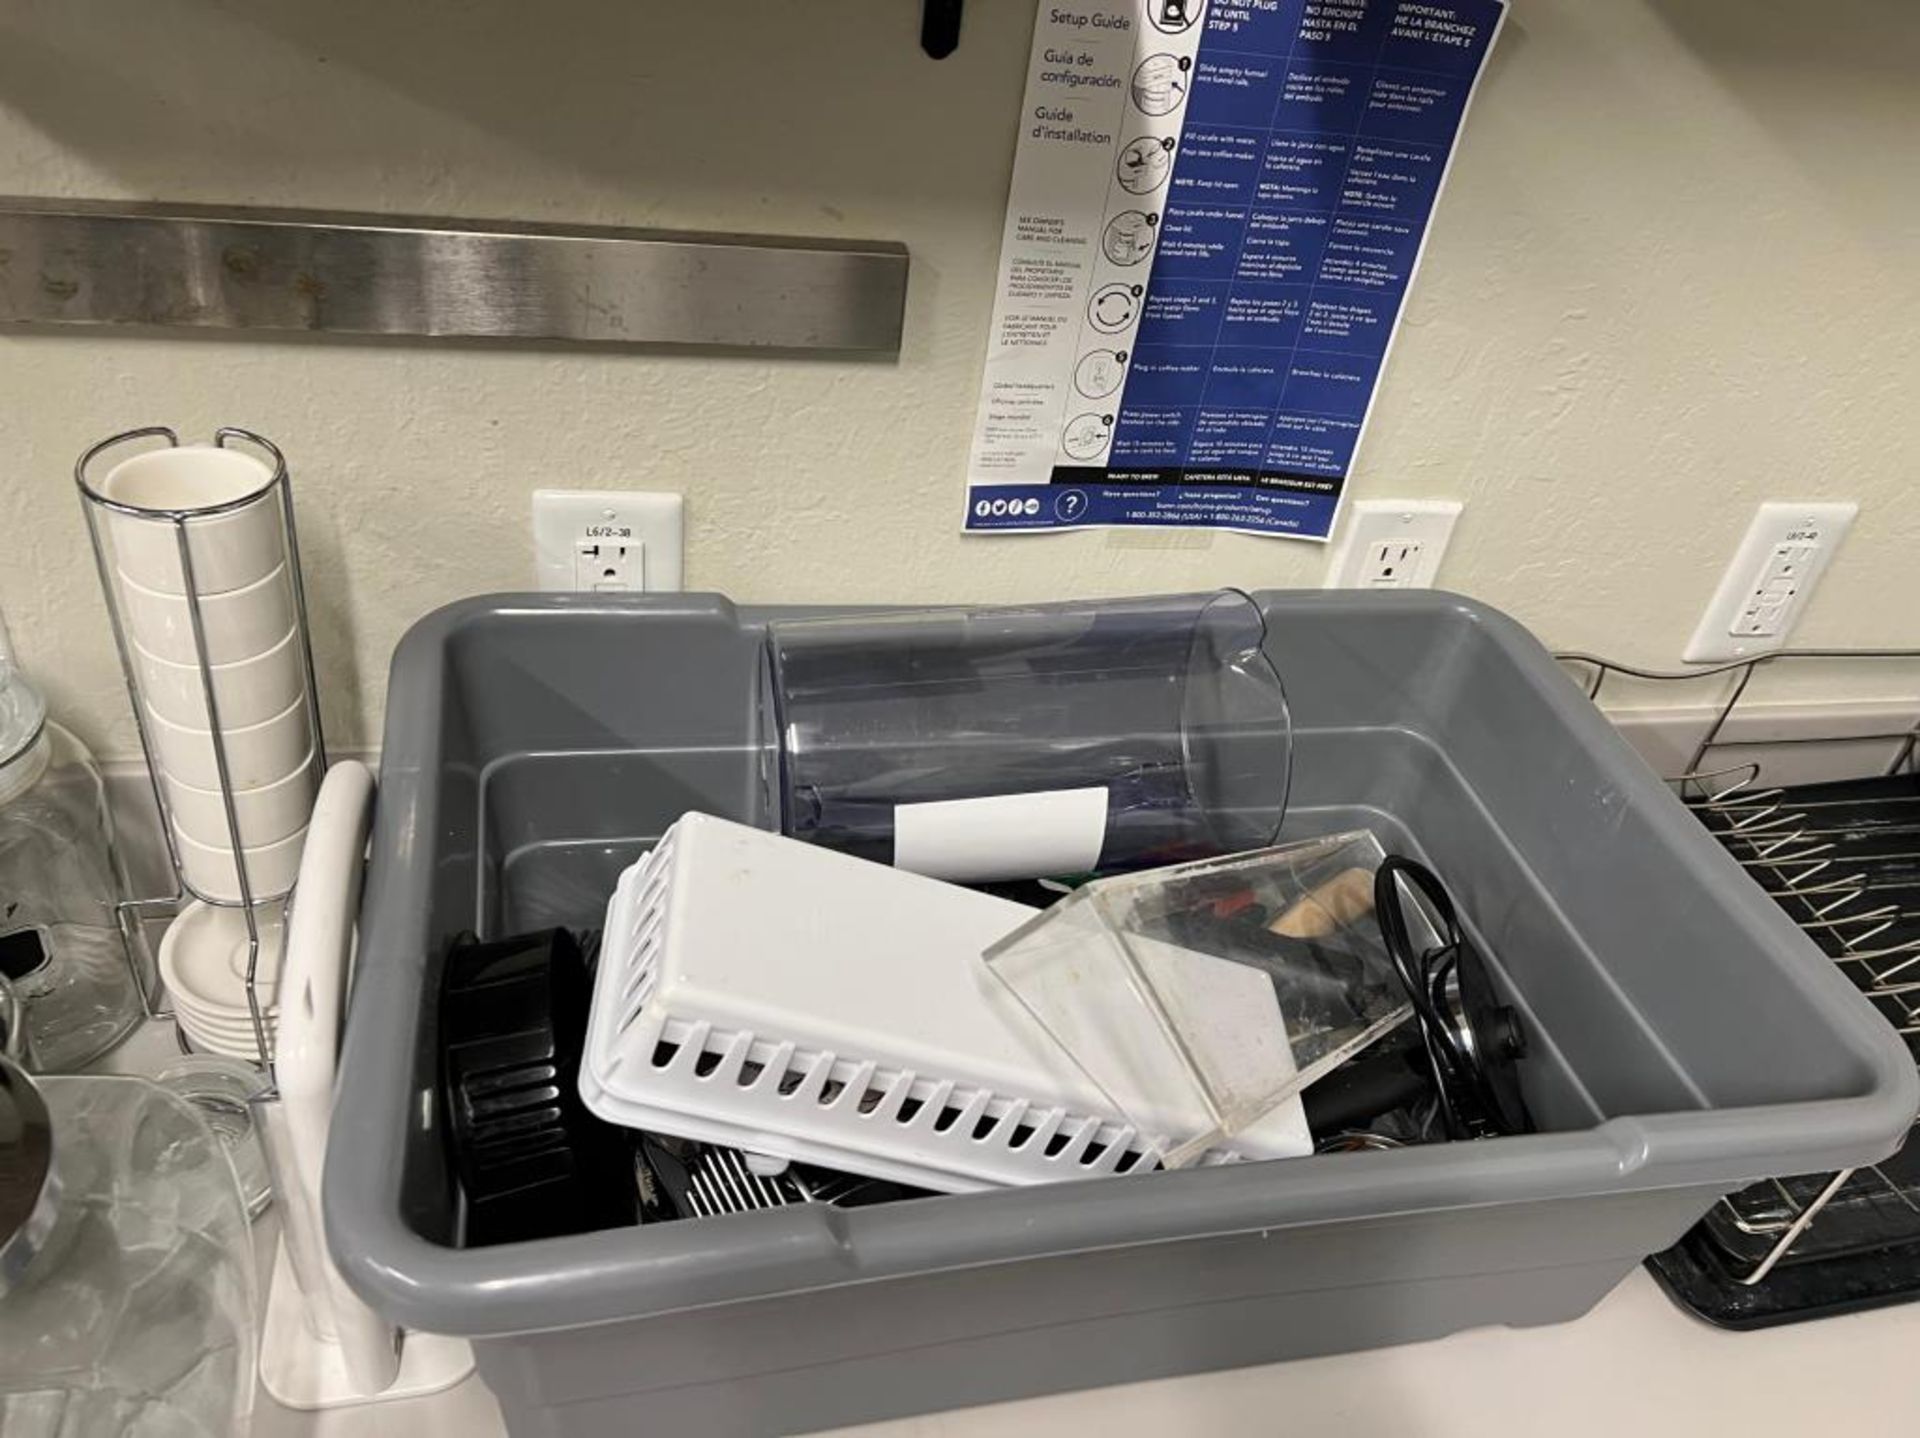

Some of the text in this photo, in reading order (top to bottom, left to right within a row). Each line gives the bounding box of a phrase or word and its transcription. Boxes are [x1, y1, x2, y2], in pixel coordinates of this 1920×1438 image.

[1051, 9, 1130, 30] Setup Guide
[1044, 49, 1094, 66] Guía de
[1040, 69, 1122, 89] configuración
[1035, 106, 1073, 121] Guide
[1033, 126, 1111, 144] d'installation
